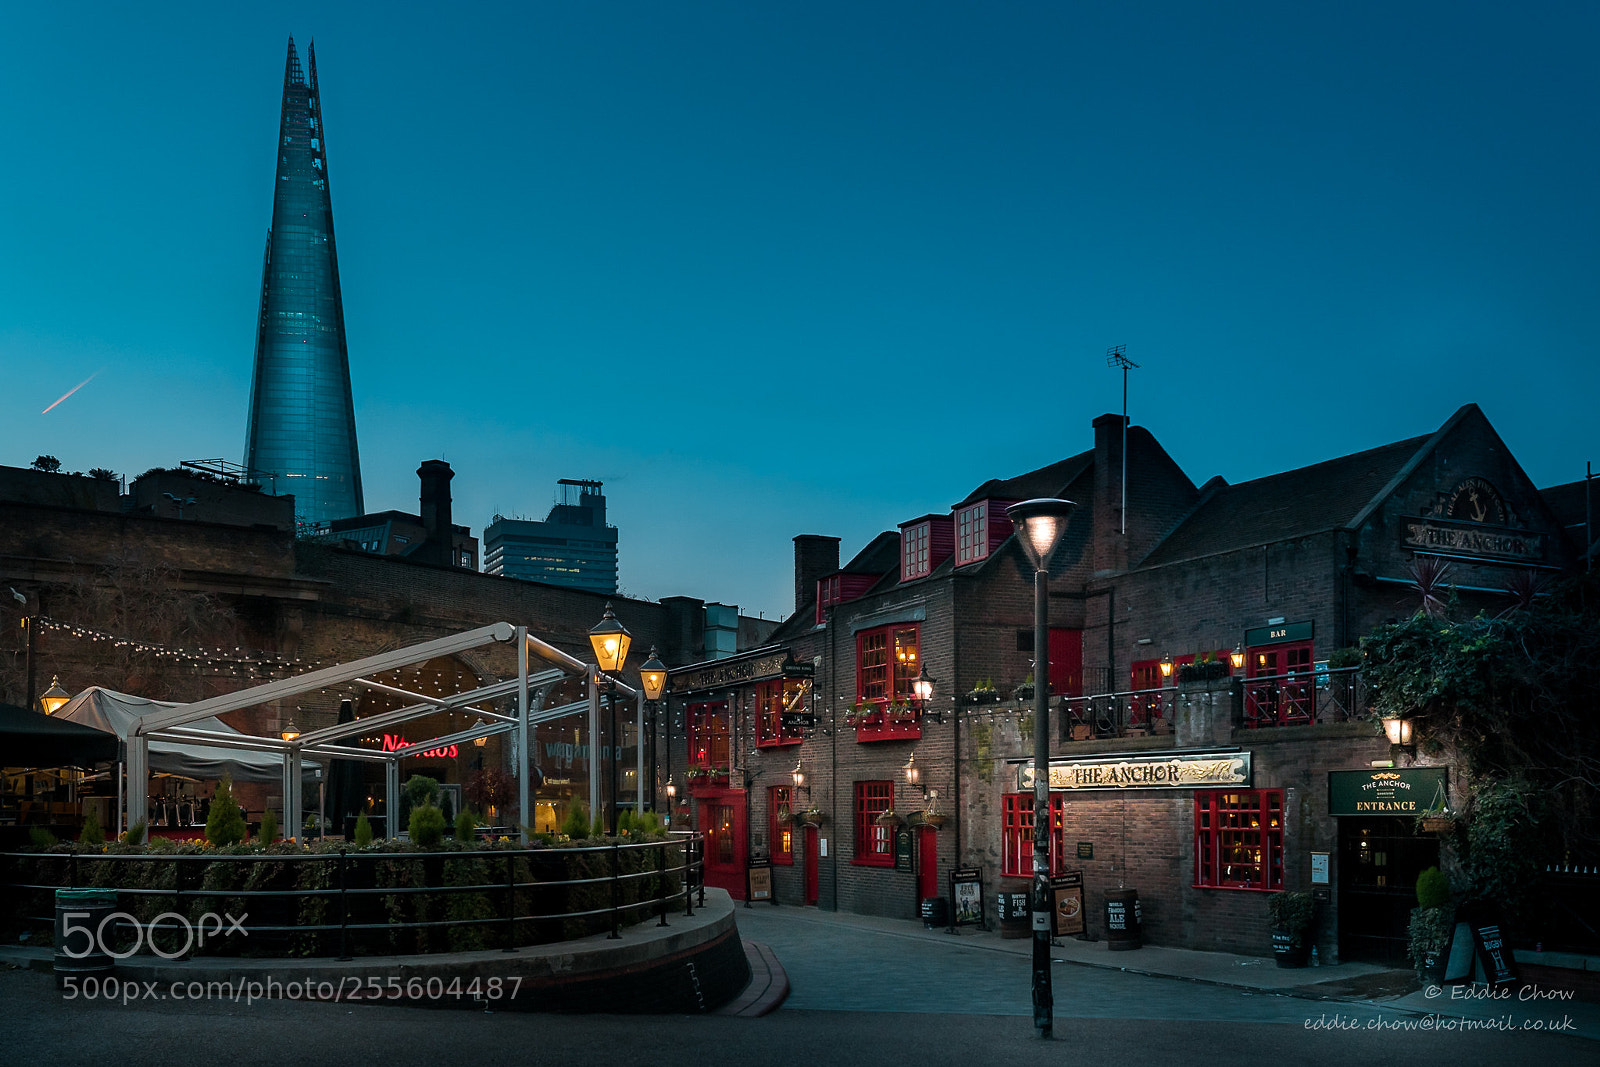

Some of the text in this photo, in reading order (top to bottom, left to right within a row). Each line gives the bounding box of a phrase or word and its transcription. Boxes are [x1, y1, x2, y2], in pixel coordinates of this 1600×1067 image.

[1459, 480, 1475, 493] ALES
[1427, 528, 1528, 553] THE ANCHOR
[1270, 629, 1287, 639] BAR
[700, 670, 717, 686] THE
[1072, 764, 1181, 784] THE ANCHOR
[1361, 780, 1411, 791] THE ANCHOR
[1356, 801, 1416, 811] ENTRANCE
[1012, 898, 1026, 907] FISH
[1109, 913, 1126, 923] ALE
